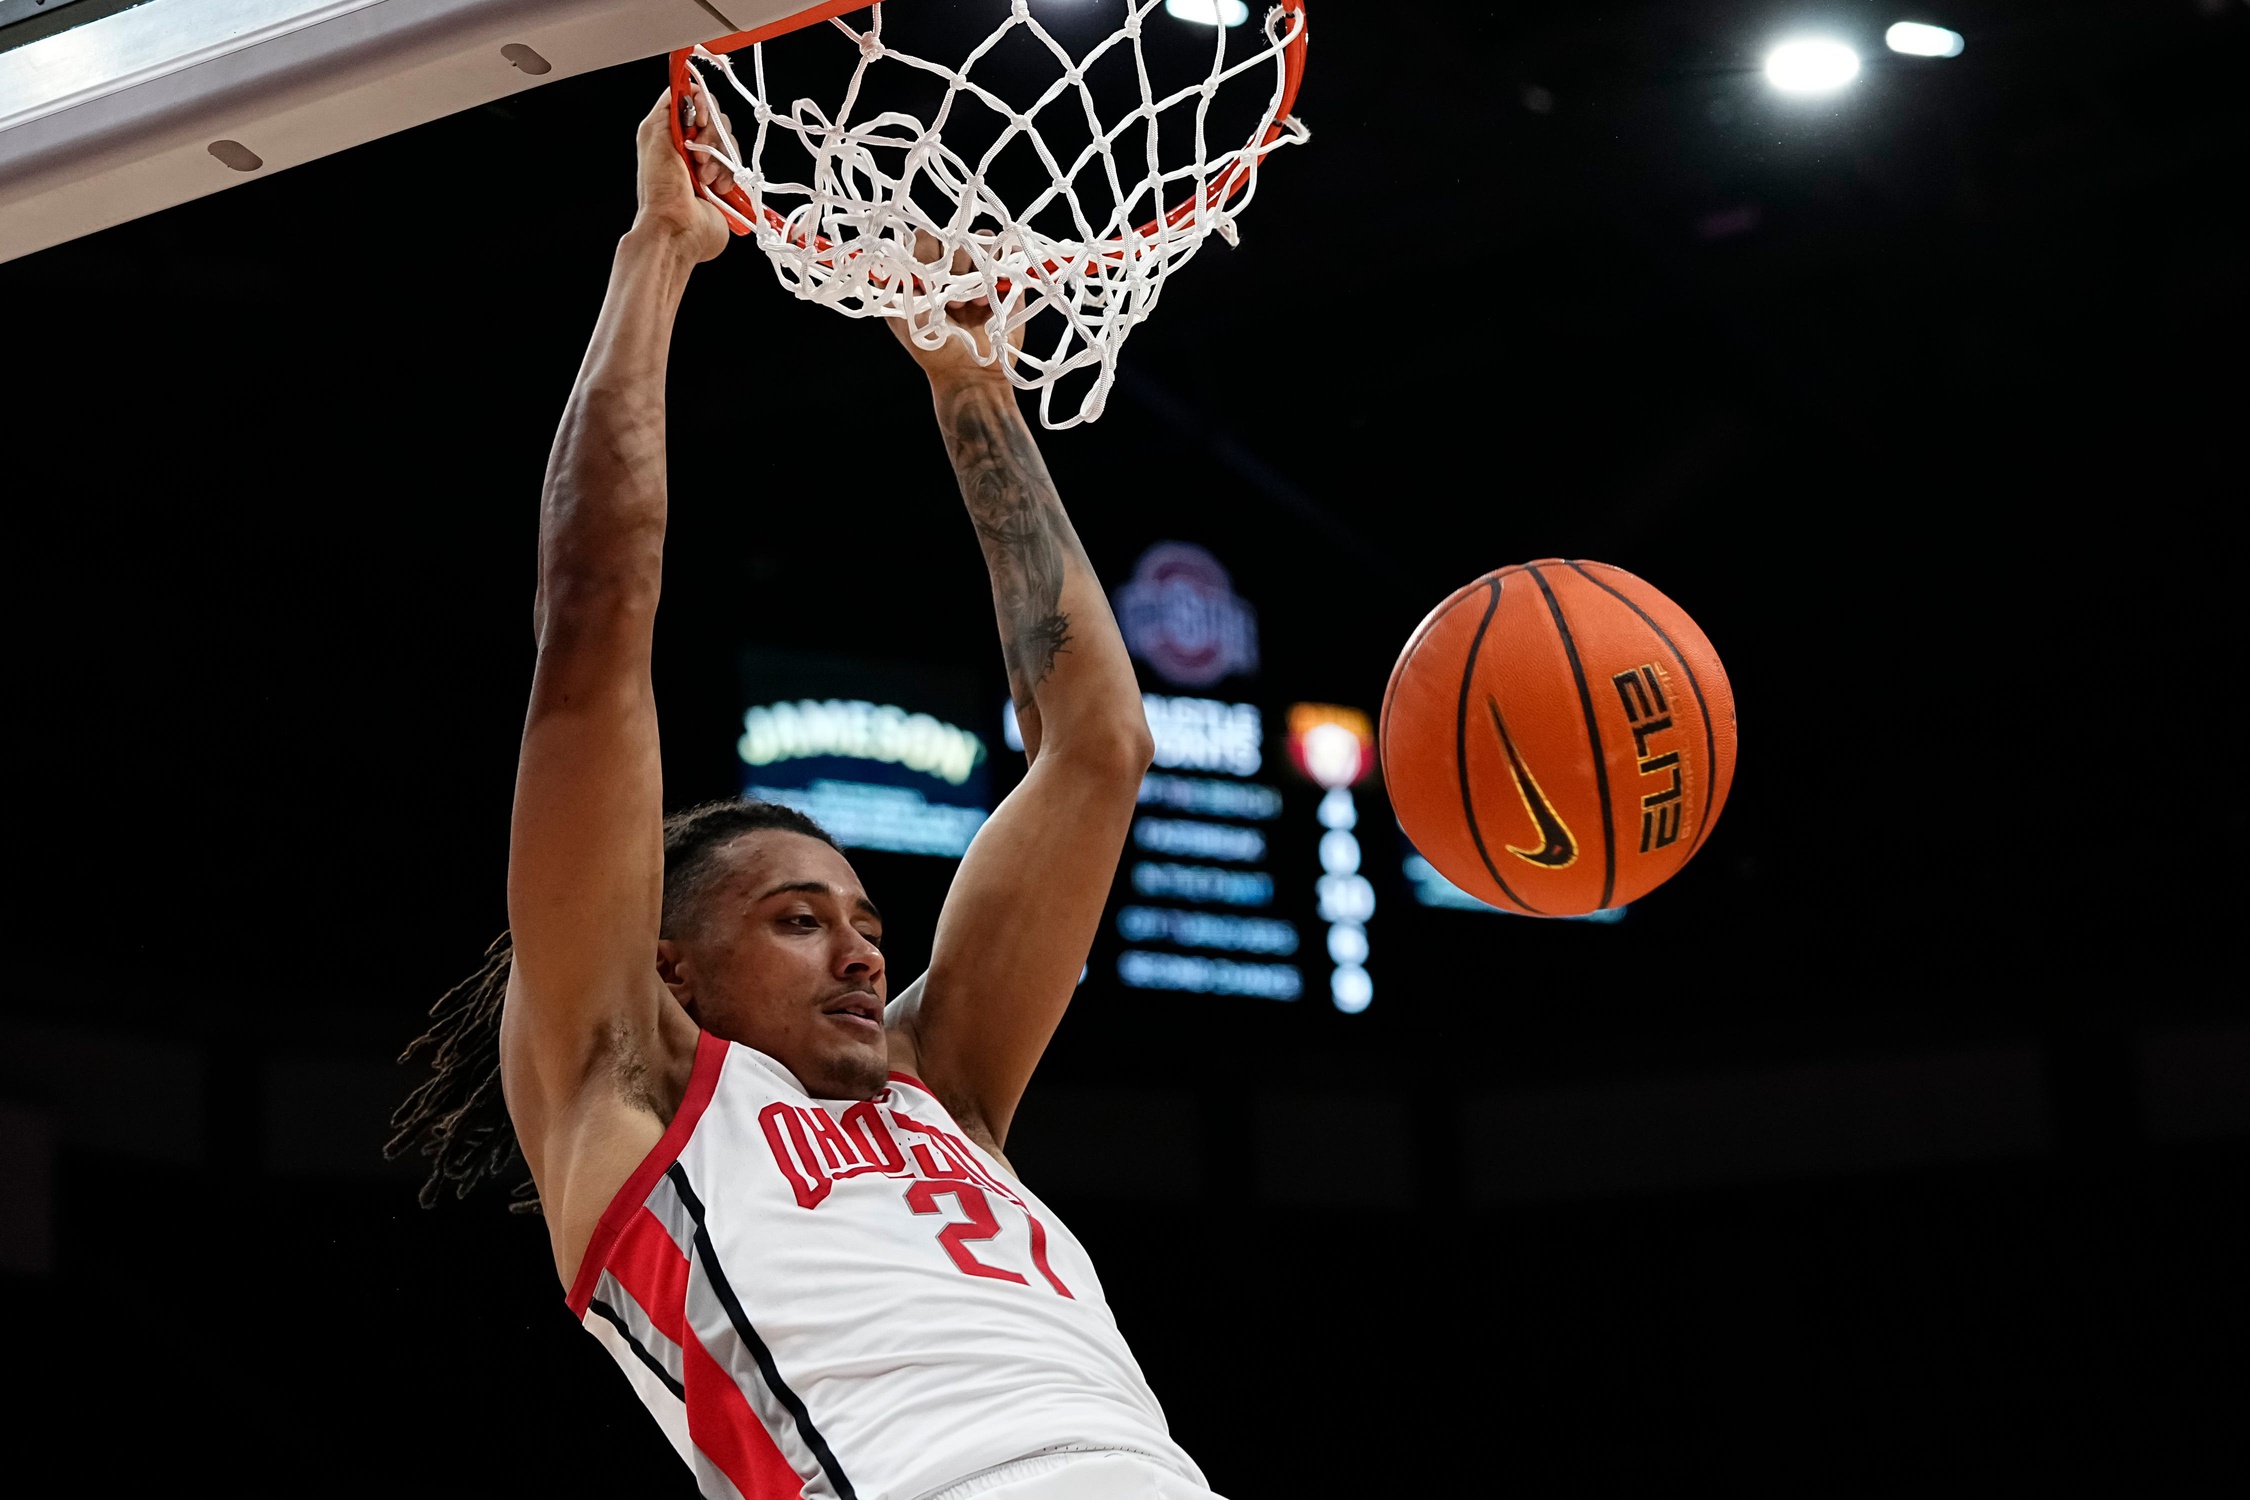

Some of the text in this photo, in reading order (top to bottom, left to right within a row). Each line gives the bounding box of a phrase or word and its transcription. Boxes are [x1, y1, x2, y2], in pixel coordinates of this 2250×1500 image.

[1611, 663, 1683, 854] ELITE
[758, 1101, 906, 1210] OHO
[903, 1180, 1076, 1300] 21
